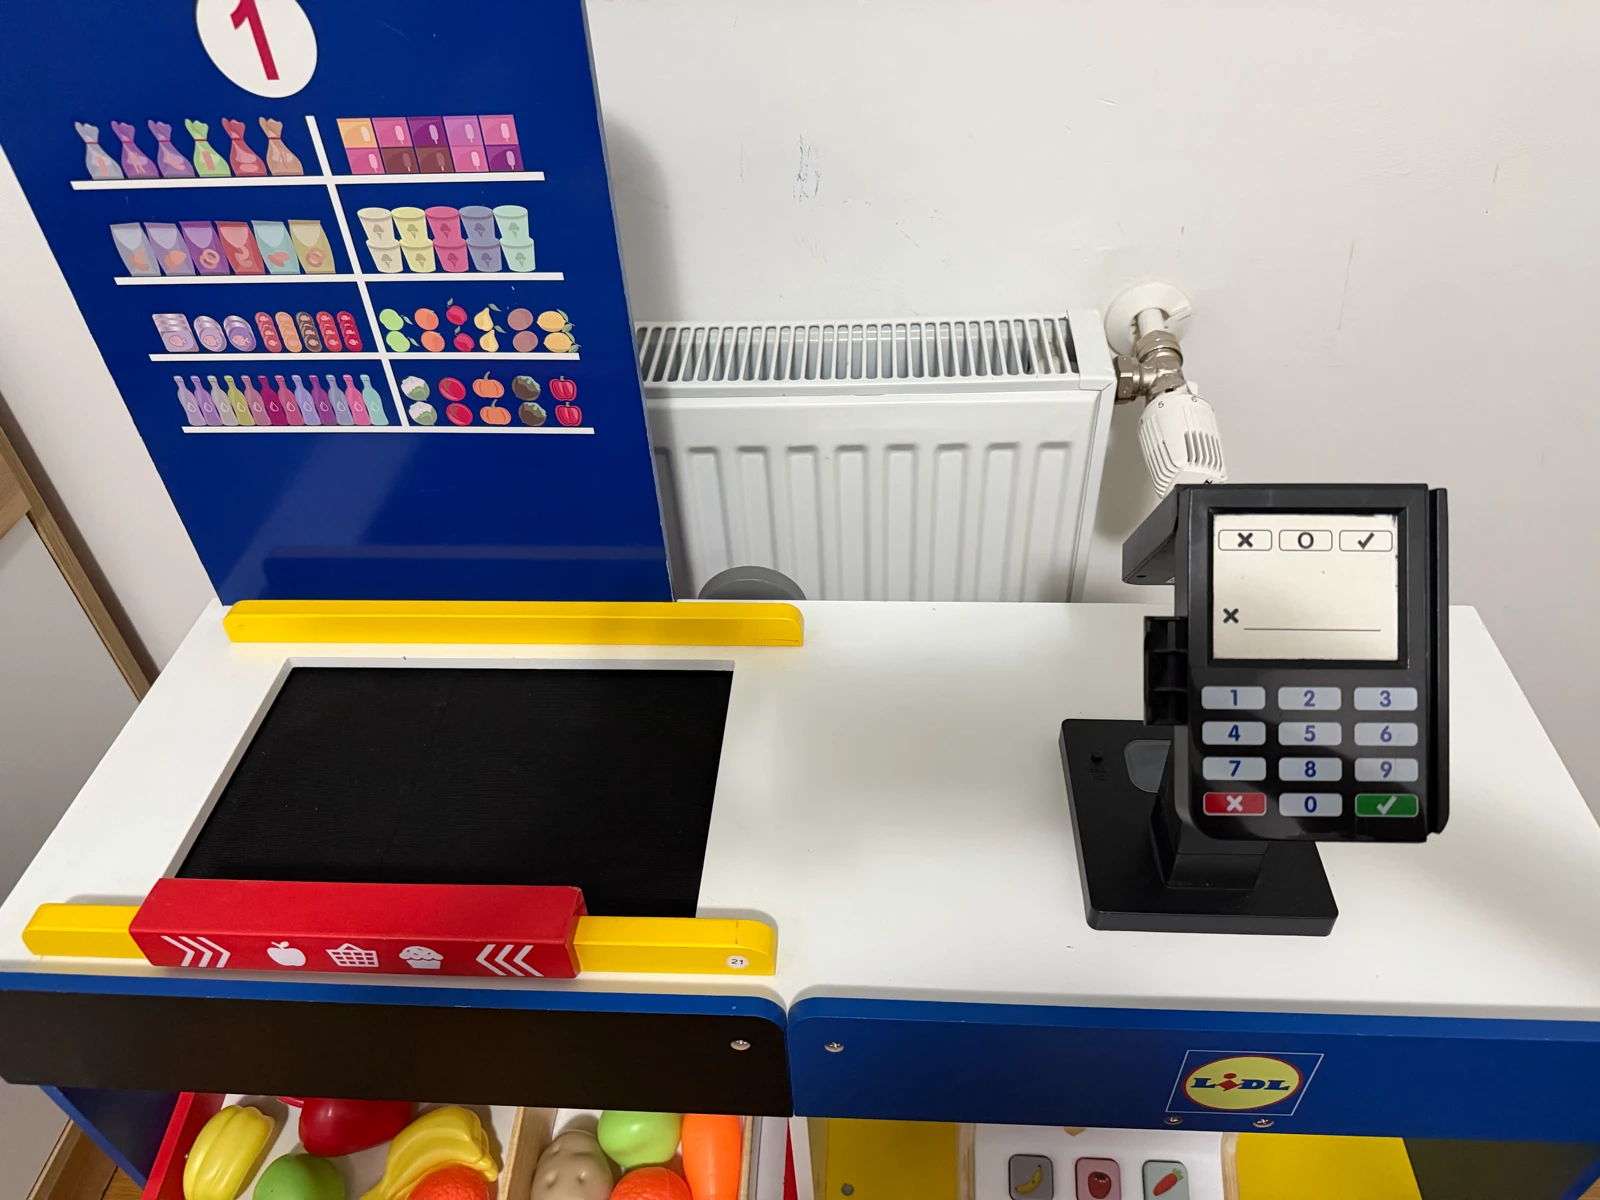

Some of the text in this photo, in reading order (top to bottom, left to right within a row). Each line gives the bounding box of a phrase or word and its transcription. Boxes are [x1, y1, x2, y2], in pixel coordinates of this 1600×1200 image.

[230, 0, 280, 80] 1
[1229, 690, 1391, 707] 1 2 3
[1227, 725, 1392, 742] 4 5 6
[1229, 760, 1392, 778] 7 8 9
[1304, 795, 1317, 813] 0
[731, 958, 744, 966] 21
